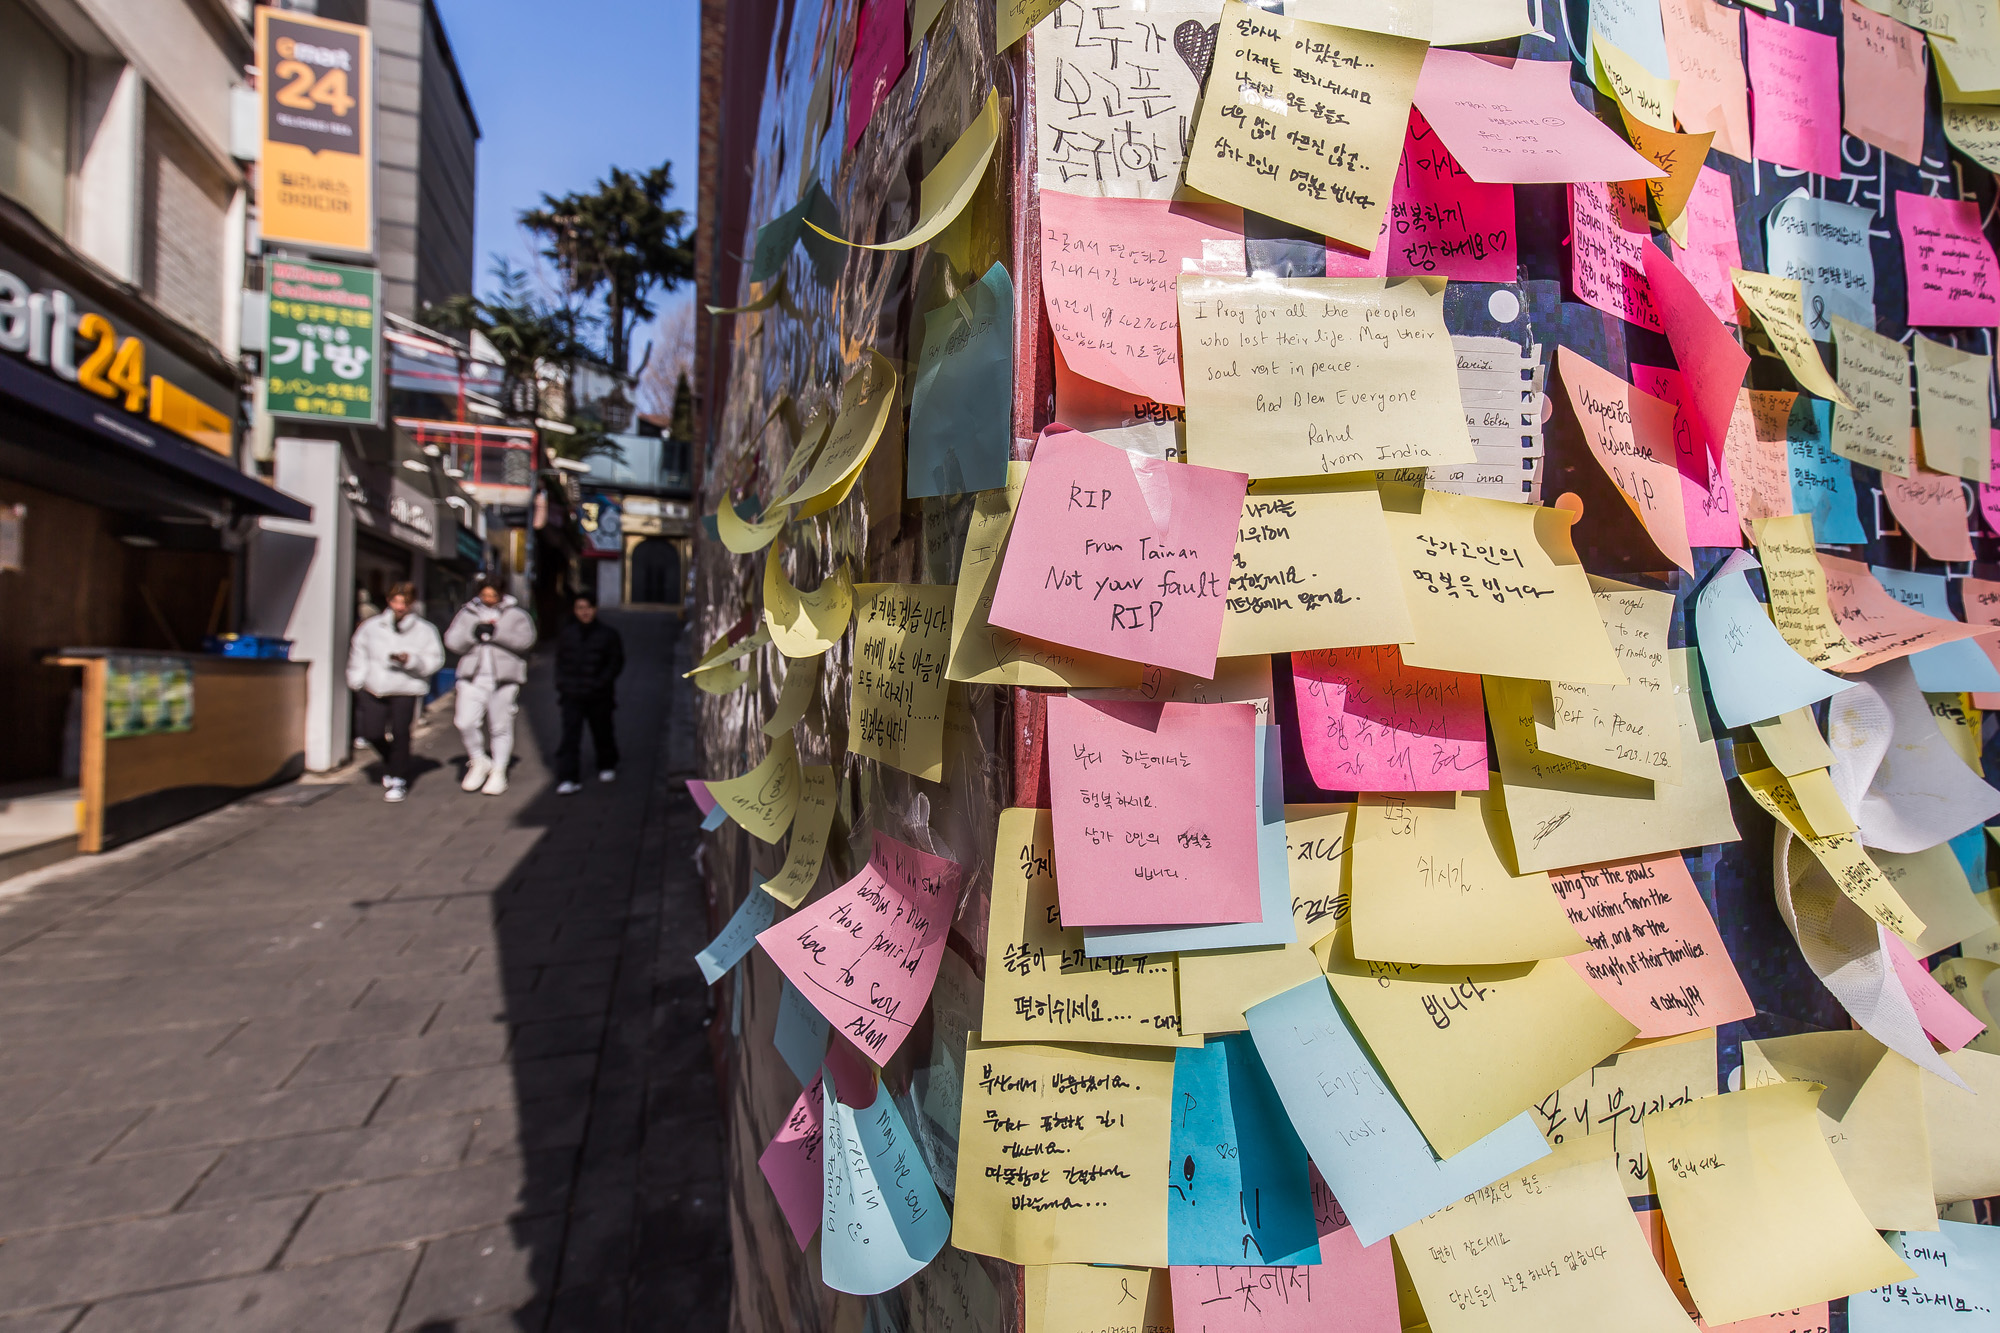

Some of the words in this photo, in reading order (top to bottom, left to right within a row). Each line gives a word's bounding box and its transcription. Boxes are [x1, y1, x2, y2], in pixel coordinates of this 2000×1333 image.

[1237, 18, 1281, 42] 얼마나
[1235, 49, 1283, 74] 이제는
[275, 60, 356, 117] 24
[1221, 104, 1247, 129] 너무
[1402, 233, 1488, 271] 건강하세요
[1194, 301, 1207, 319] I
[1216, 299, 1245, 324] Pray
[1255, 307, 1276, 324] for
[1286, 302, 1308, 318] all
[1322, 303, 1349, 318] the
[1200, 333, 1230, 347] who
[1240, 331, 1268, 347] lost
[1276, 331, 1308, 346] their
[1359, 326, 1389, 348] May
[1397, 328, 1435, 340] their
[270, 336, 371, 380] 가방
[1208, 360, 1241, 380] soul
[1251, 360, 1279, 375] rest
[1290, 361, 1304, 376] in
[1257, 394, 1282, 412] God
[1336, 389, 1417, 411] Everyone
[1309, 423, 1354, 445] Rahul
[1321, 451, 1363, 472] from
[1477, 473, 1504, 484] inna
[1067, 480, 1112, 512] RIP
[1044, 565, 1084, 590] Not
[1093, 576, 1144, 600] your
[1157, 569, 1223, 598] fault
[1110, 601, 1164, 632] RIP
[1615, 623, 1628, 636] to
[1635, 629, 1650, 640] see
[1552, 696, 1584, 723] Rest
[1073, 743, 1102, 770] 부디
[1122, 750, 1191, 769] 하늘에서는
[1085, 827, 1114, 846] 삼가
[1125, 831, 1160, 845] 고인의
[1580, 870, 1600, 890] for
[1600, 868, 1624, 885] the
[1626, 863, 1655, 884] souls
[1567, 907, 1588, 925] the
[1588, 900, 1624, 920] victims
[1623, 892, 1652, 910] from
[1649, 888, 1673, 906] the
[1612, 927, 1632, 945] and
[1632, 922, 1649, 937] for
[1646, 920, 1670, 936] the
[1003, 942, 1046, 976] 슬픔이
[1586, 956, 1629, 986] strength
[1629, 956, 1640, 973] of
[1639, 948, 1663, 970] their
[979, 1063, 1037, 1095] 부산에서
[847, 1138, 870, 1178] rest
[861, 1185, 880, 1210] in
[894, 1150, 911, 1188] the
[905, 1190, 928, 1224] soul
[1428, 1245, 1456, 1264] 편히
[1463, 1232, 1511, 1256] 잠드세요
[1449, 1283, 1497, 1311] 당신들의
[1502, 1272, 1528, 1293] 잘못
[1528, 1261, 1560, 1281] 하나도
[1563, 1245, 1608, 1271] 없습니다
